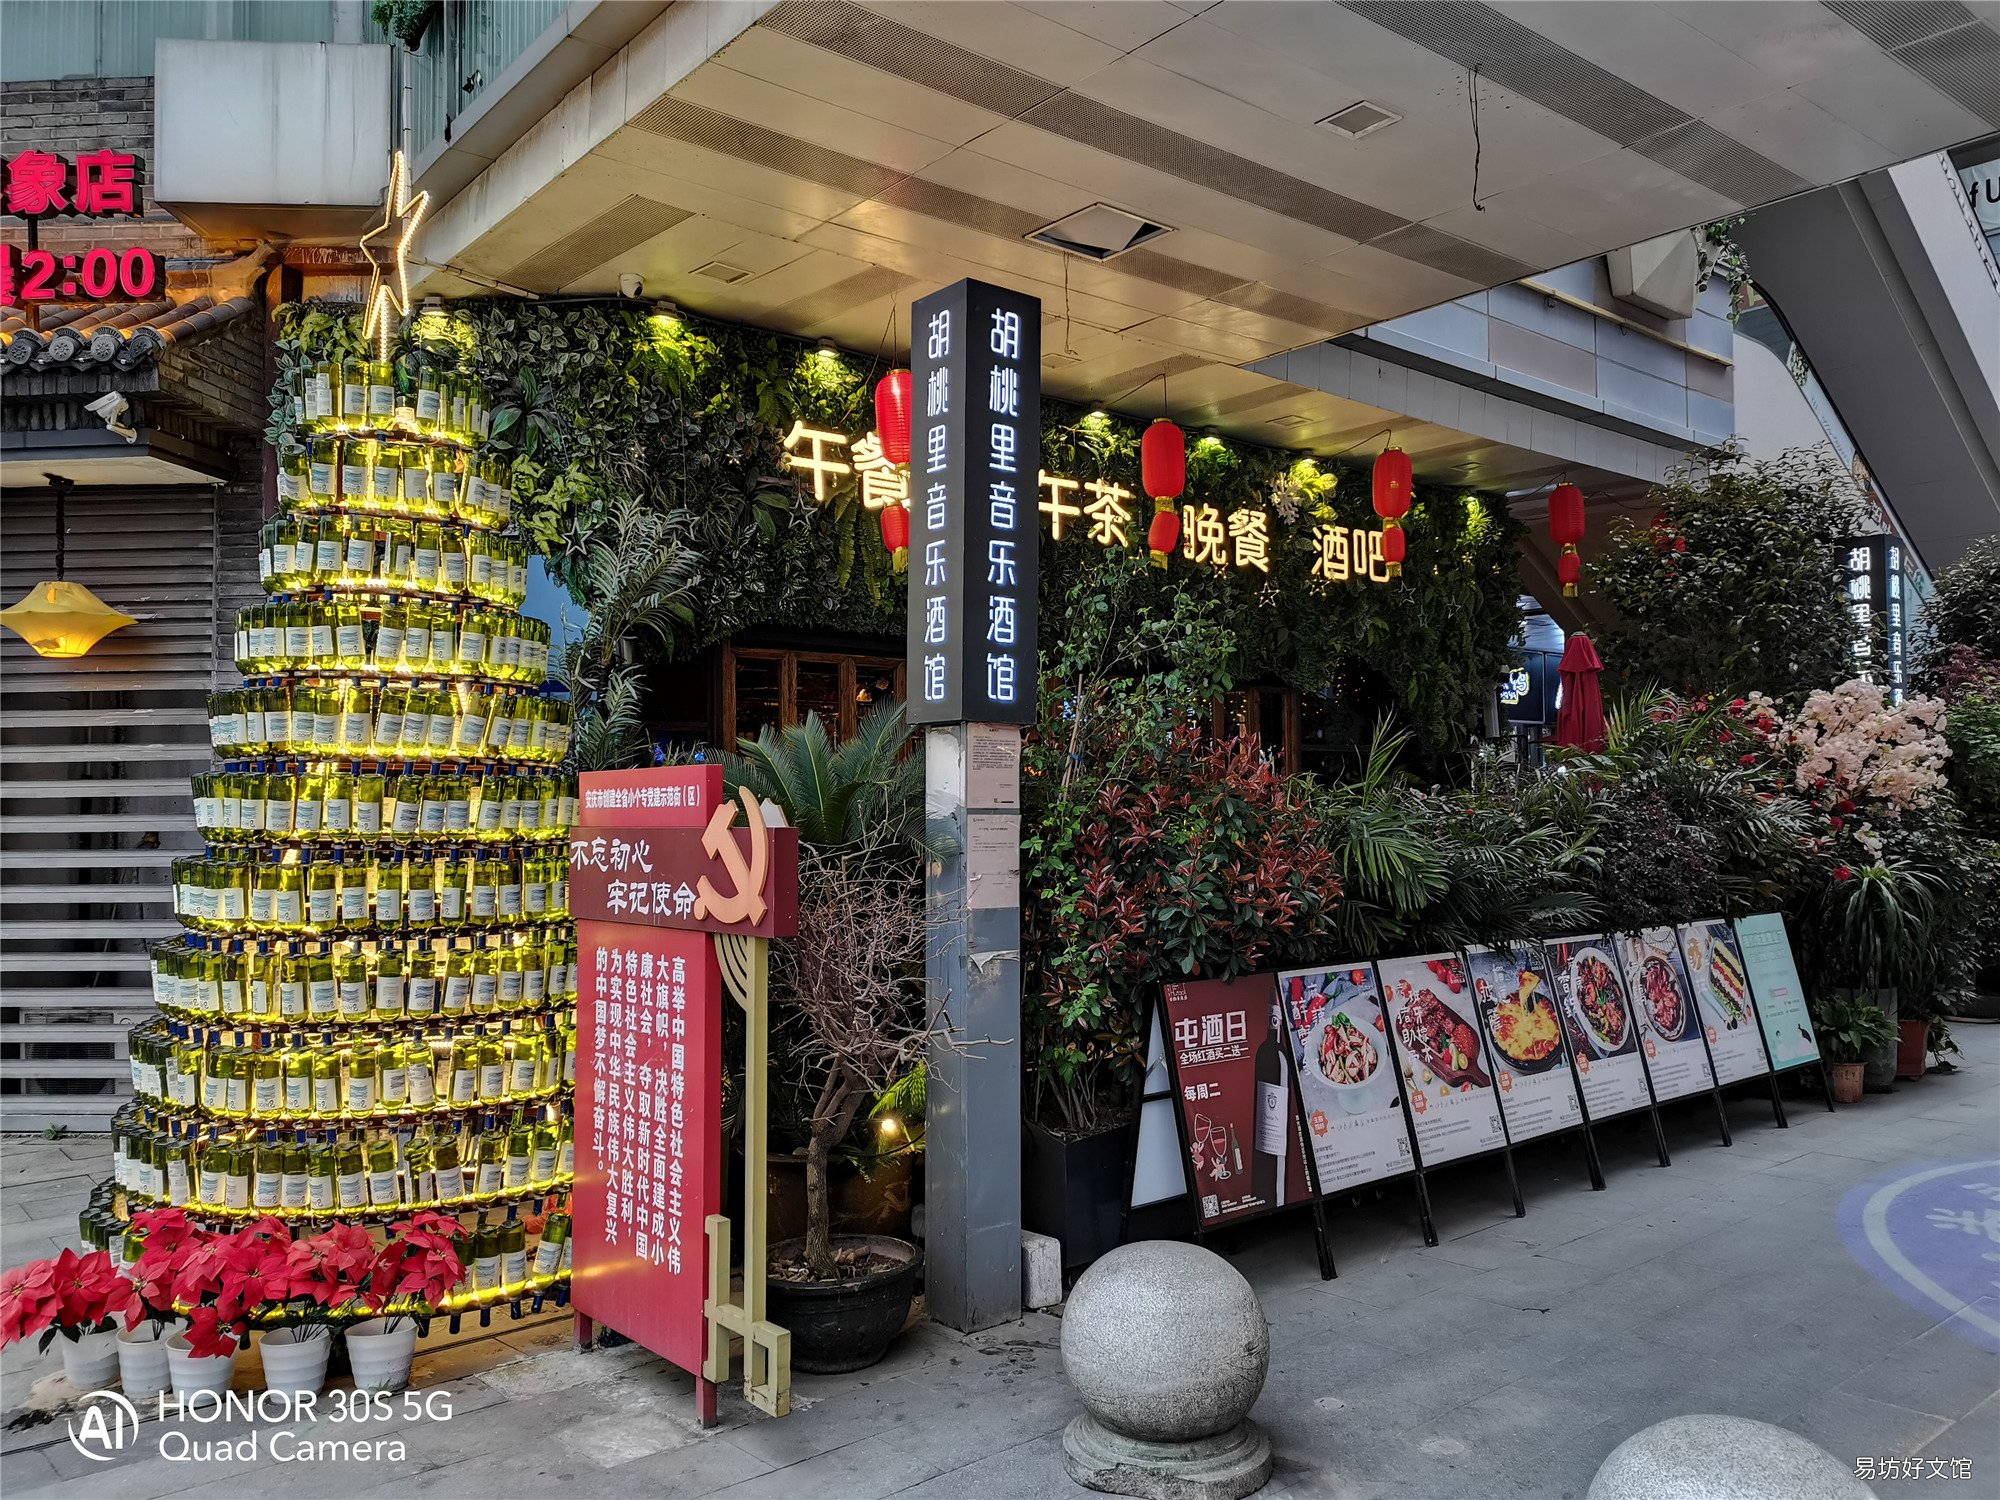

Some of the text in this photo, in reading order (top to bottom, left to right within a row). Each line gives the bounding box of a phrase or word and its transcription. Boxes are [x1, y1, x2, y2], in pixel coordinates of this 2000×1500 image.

[5, 149, 136, 214] 象店
[923, 308, 951, 702] 胡桃里音乐酒馆
[986, 307, 1020, 702] 胡桃里音乐酒馆
[1182, 502, 1271, 574] 晚餐
[1311, 522, 1391, 583] 酒吧
[569, 836, 654, 874] 不忘初心
[606, 878, 697, 920] 牢记使命
[1174, 1010, 1248, 1049] 屯酒日
[1179, 1044, 1249, 1066] 全场红酒买二送一
[604, 947, 623, 1246] 为实现中华民族伟大复兴
[667, 955, 686, 1276] 高举中国特色社会主义伟
[1183, 1083, 1221, 1102] 每周二
